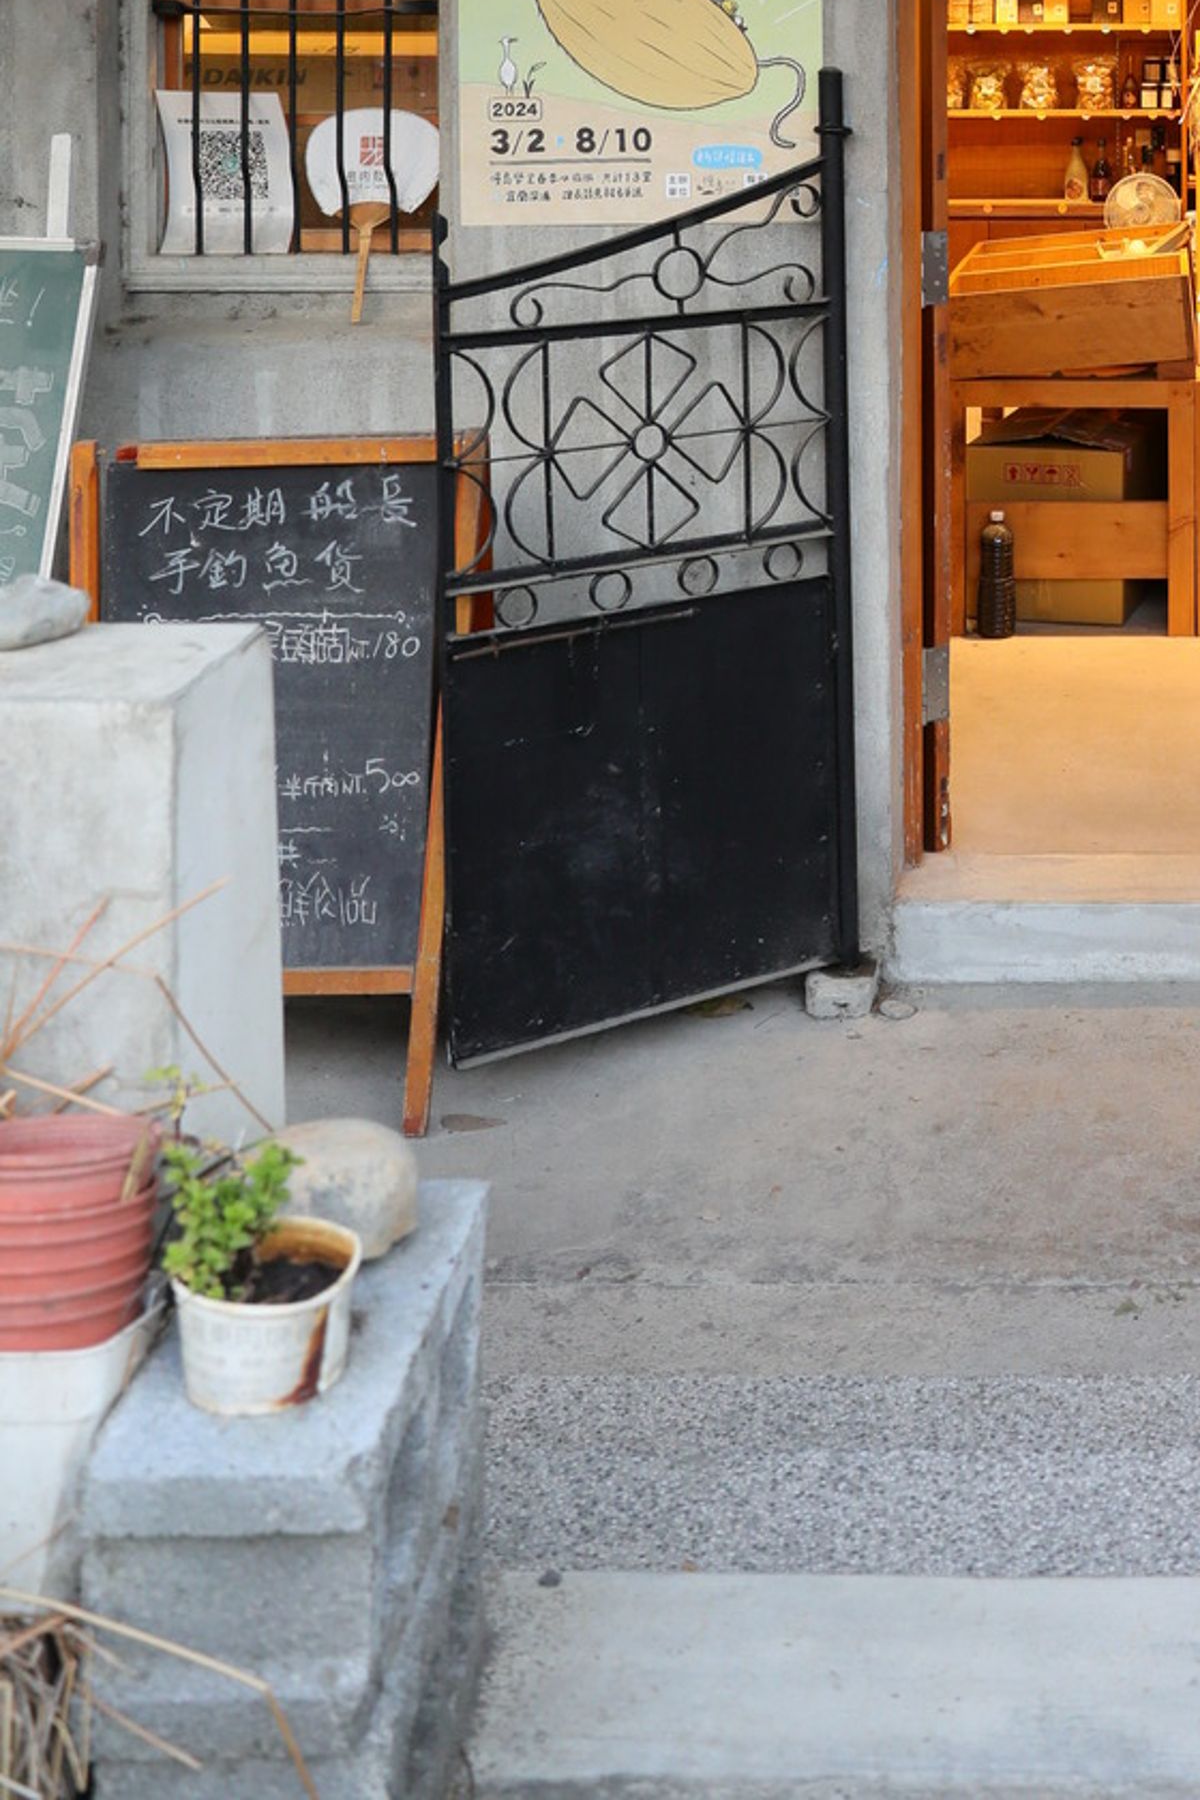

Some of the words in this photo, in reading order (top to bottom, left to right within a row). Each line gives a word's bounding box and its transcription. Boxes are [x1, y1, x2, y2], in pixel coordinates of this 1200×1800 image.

[492, 102, 538, 117] 2024
[490, 128, 545, 155] 3/2
[575, 127, 652, 155] 8/10
[149, 540, 365, 595] 手釣魚貨
